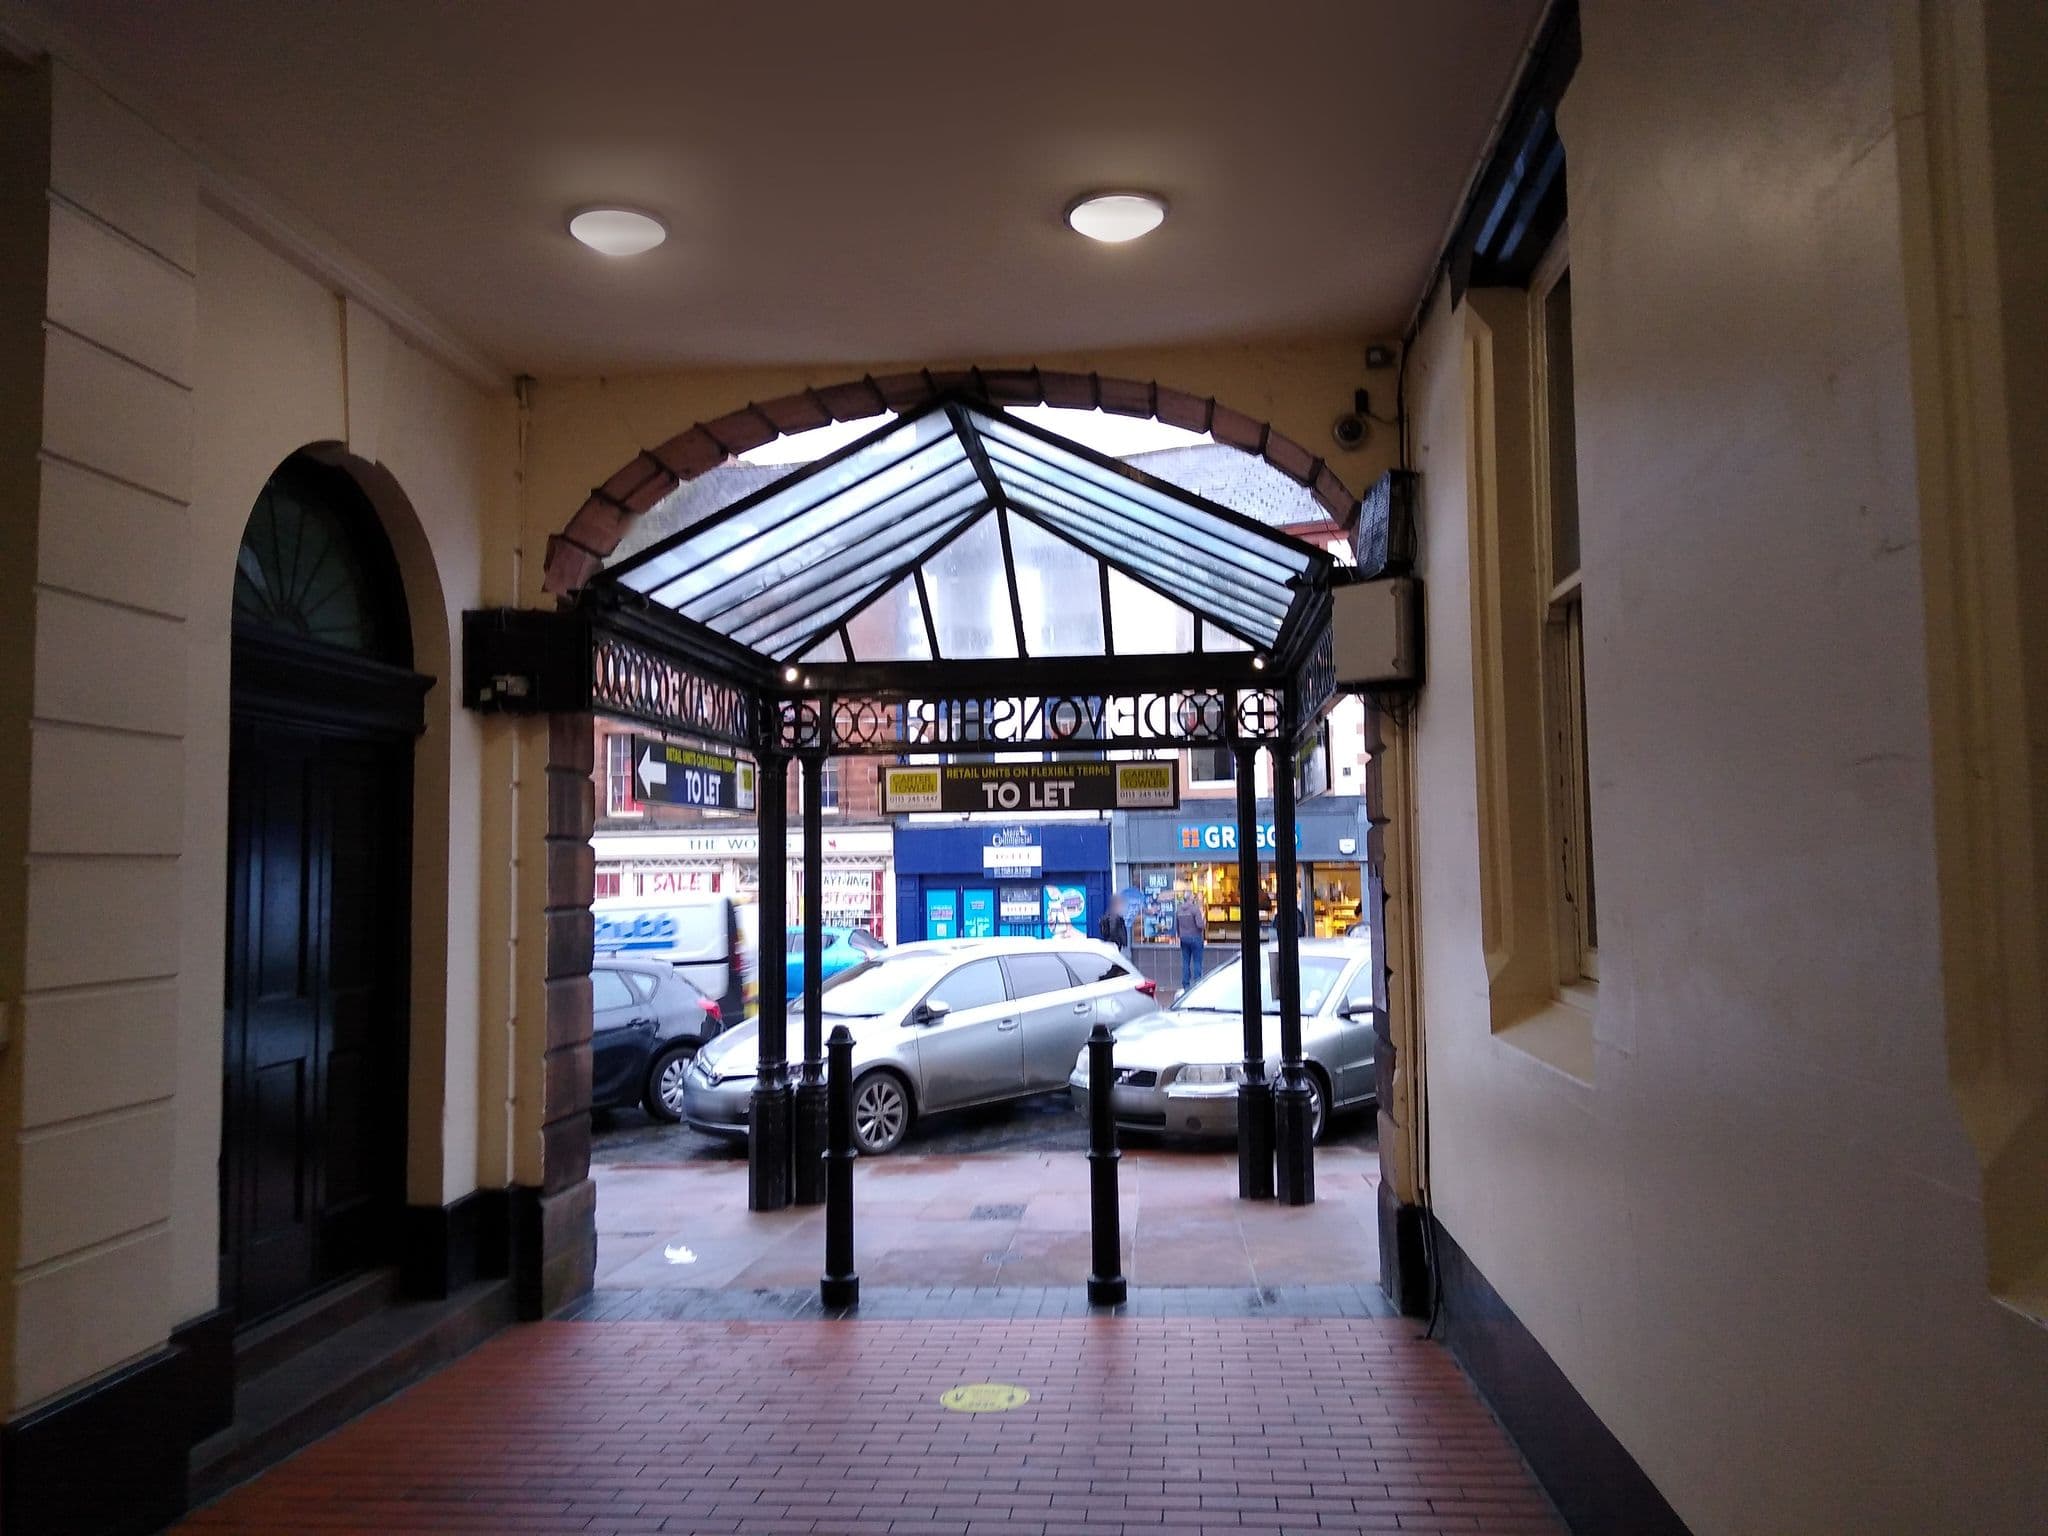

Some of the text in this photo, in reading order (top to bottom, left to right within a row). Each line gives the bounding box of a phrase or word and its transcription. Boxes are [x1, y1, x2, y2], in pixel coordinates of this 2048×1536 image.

[946, 764, 1111, 779] RETAIL UNITS ON FLEXIBLE TERMS
[685, 769, 701, 804] TO
[703, 772, 720, 806] LET
[982, 780, 1075, 809] TO LET
[654, 871, 701, 892] SALE
